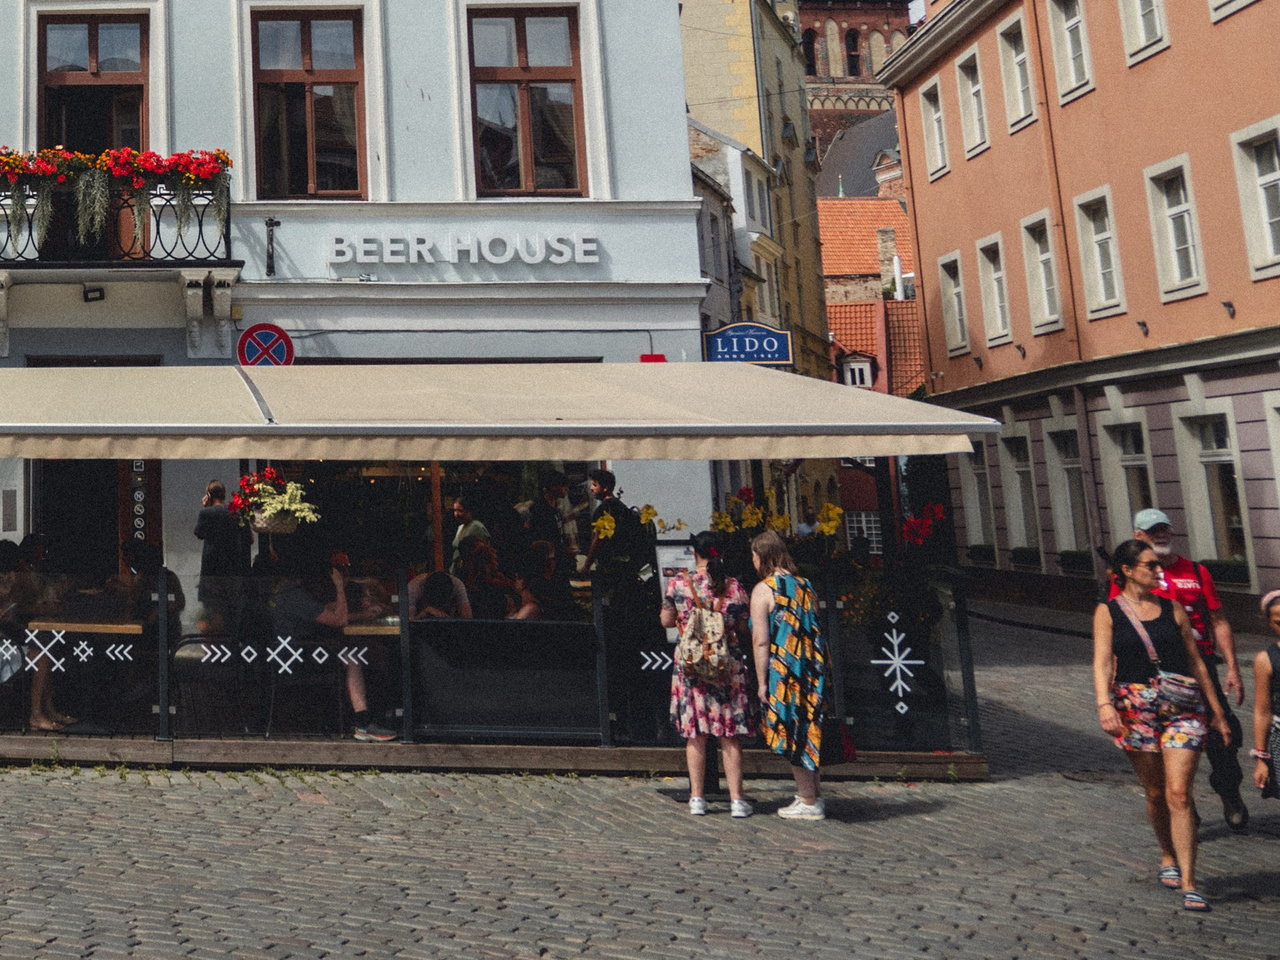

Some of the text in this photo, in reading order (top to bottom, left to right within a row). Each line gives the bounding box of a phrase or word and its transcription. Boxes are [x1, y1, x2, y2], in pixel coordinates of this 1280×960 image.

[329, 231, 600, 265] BEER HOUSE
[717, 337, 778, 352] LIDO
